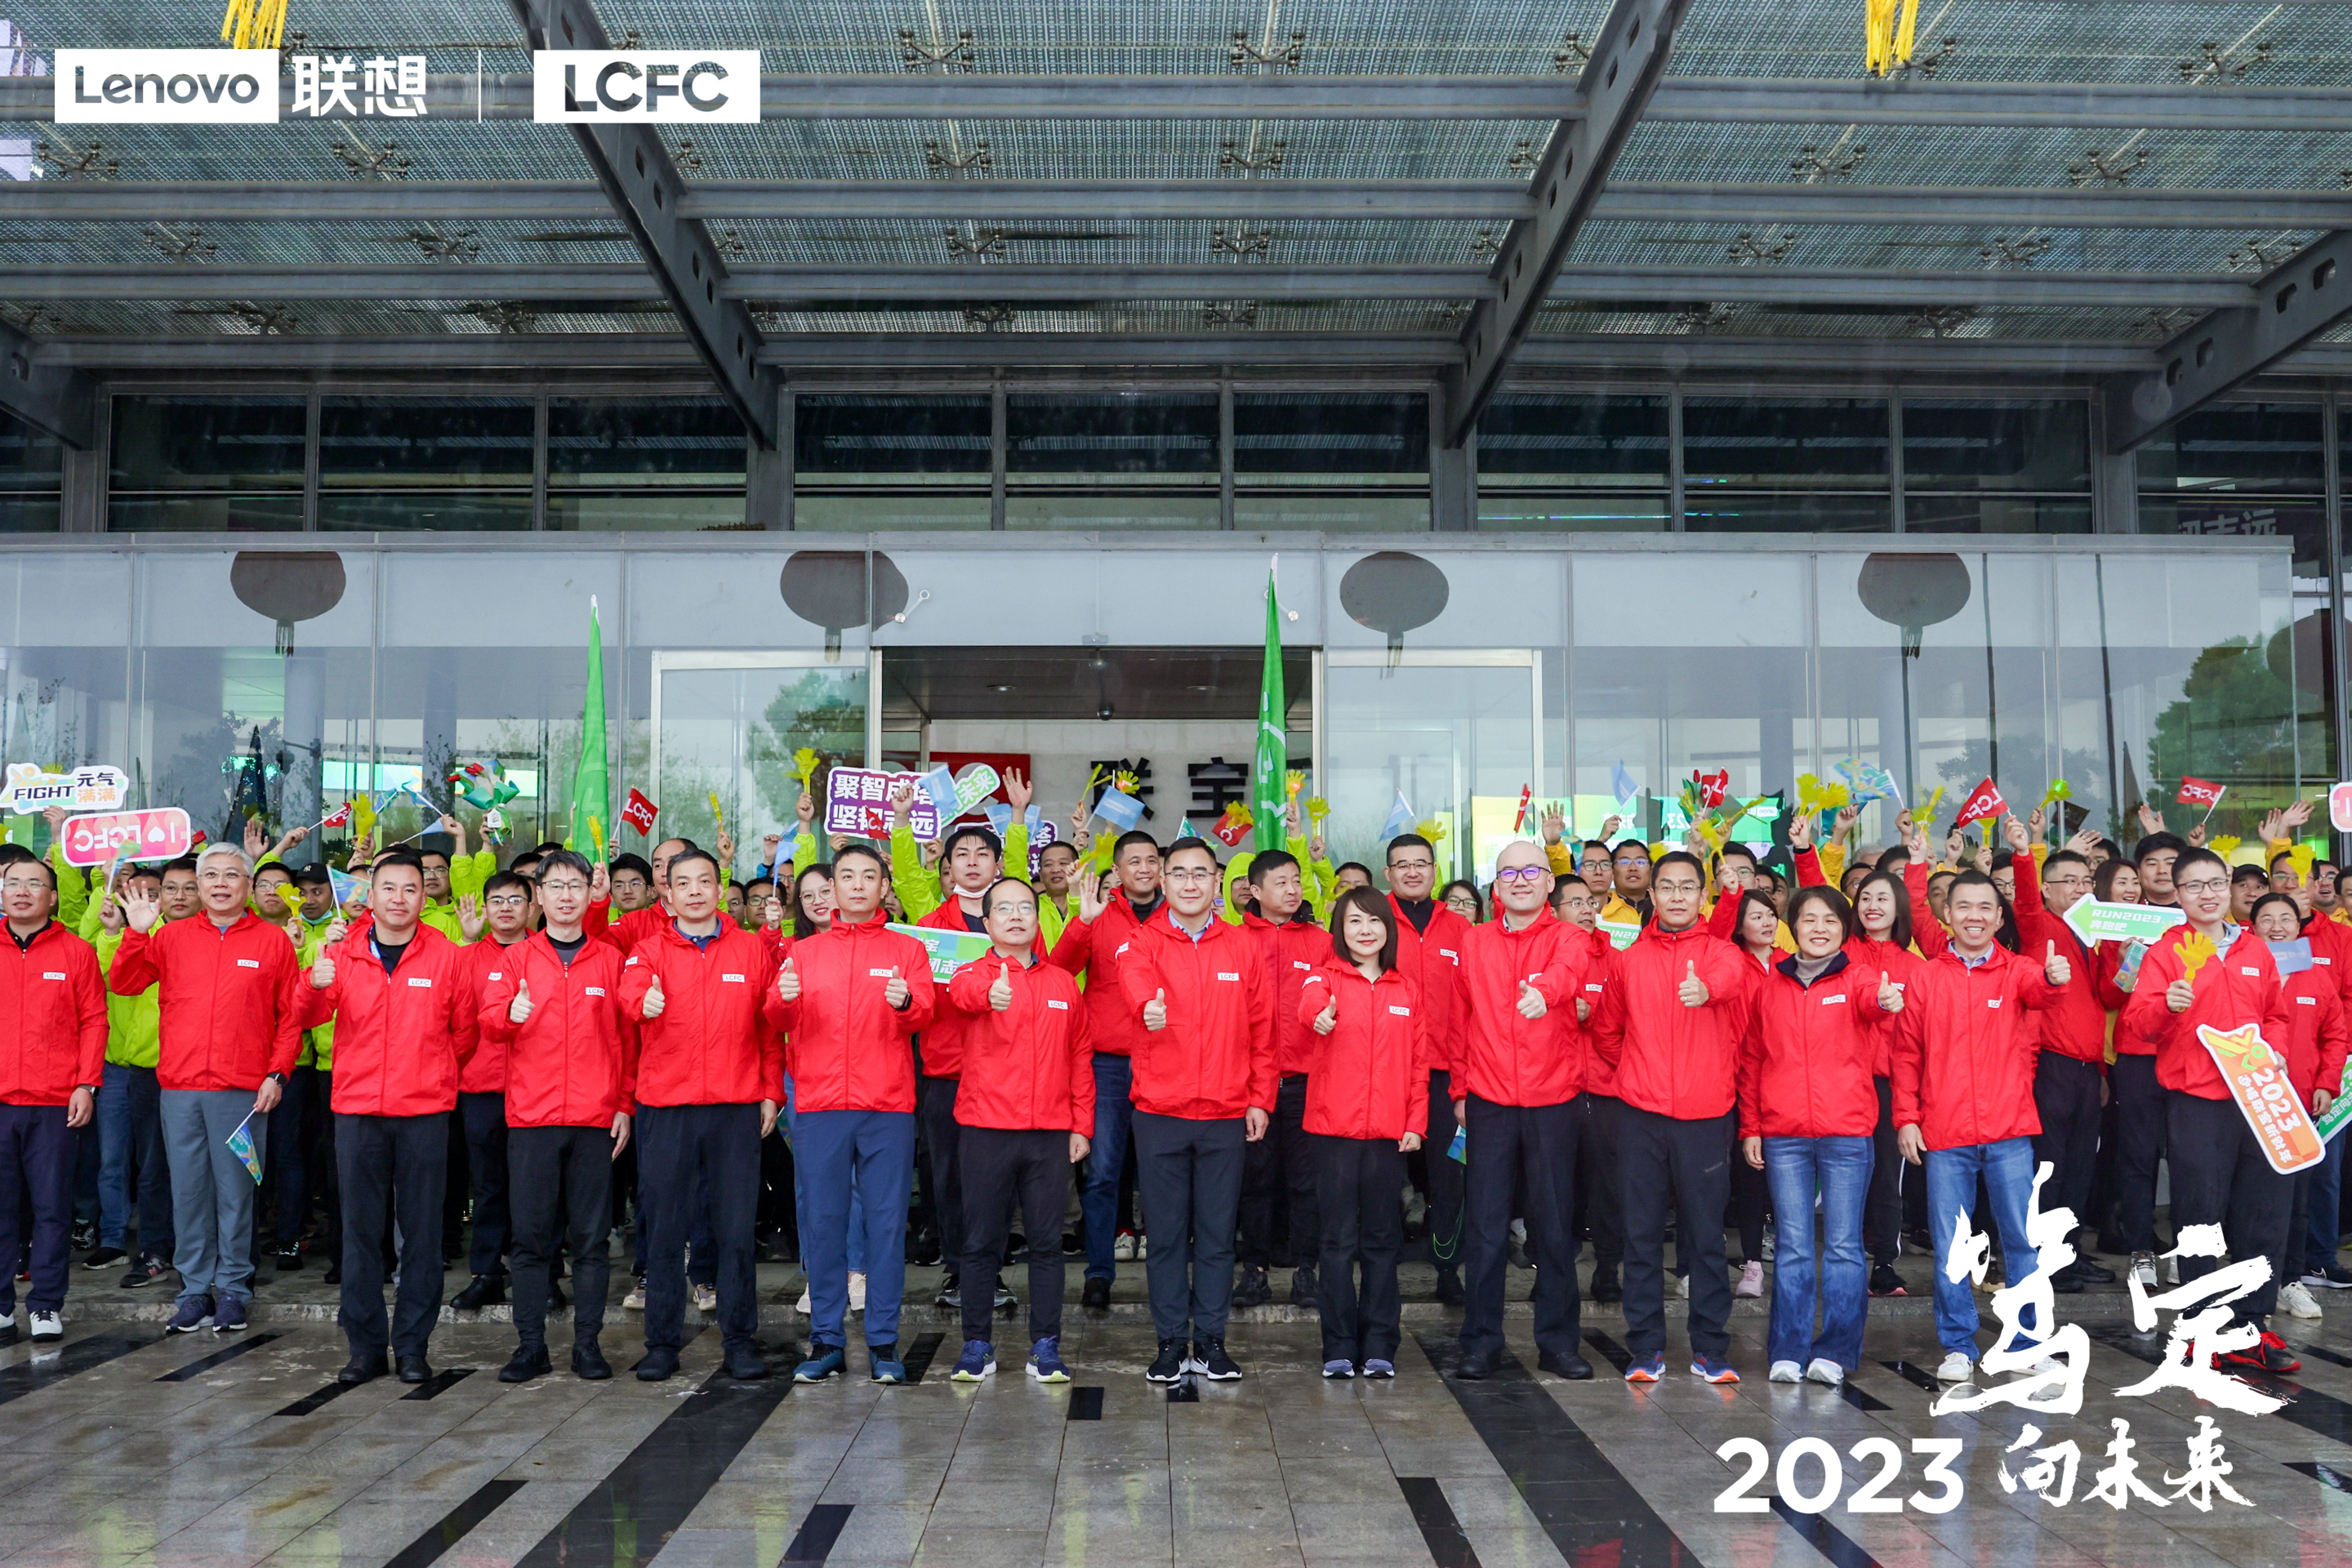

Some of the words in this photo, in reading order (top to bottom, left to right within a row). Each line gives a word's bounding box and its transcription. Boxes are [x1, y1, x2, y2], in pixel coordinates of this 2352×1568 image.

[77, 773, 115, 787] 元气
[14, 786, 74, 800] FIGHT
[78, 787, 116, 803] 满满
[624, 798, 653, 827] LCFC
[2091, 909, 2162, 924] RUN2023
[2090, 920, 2127, 932] 奔跑吧
[2252, 1068, 2301, 1131] 2023
